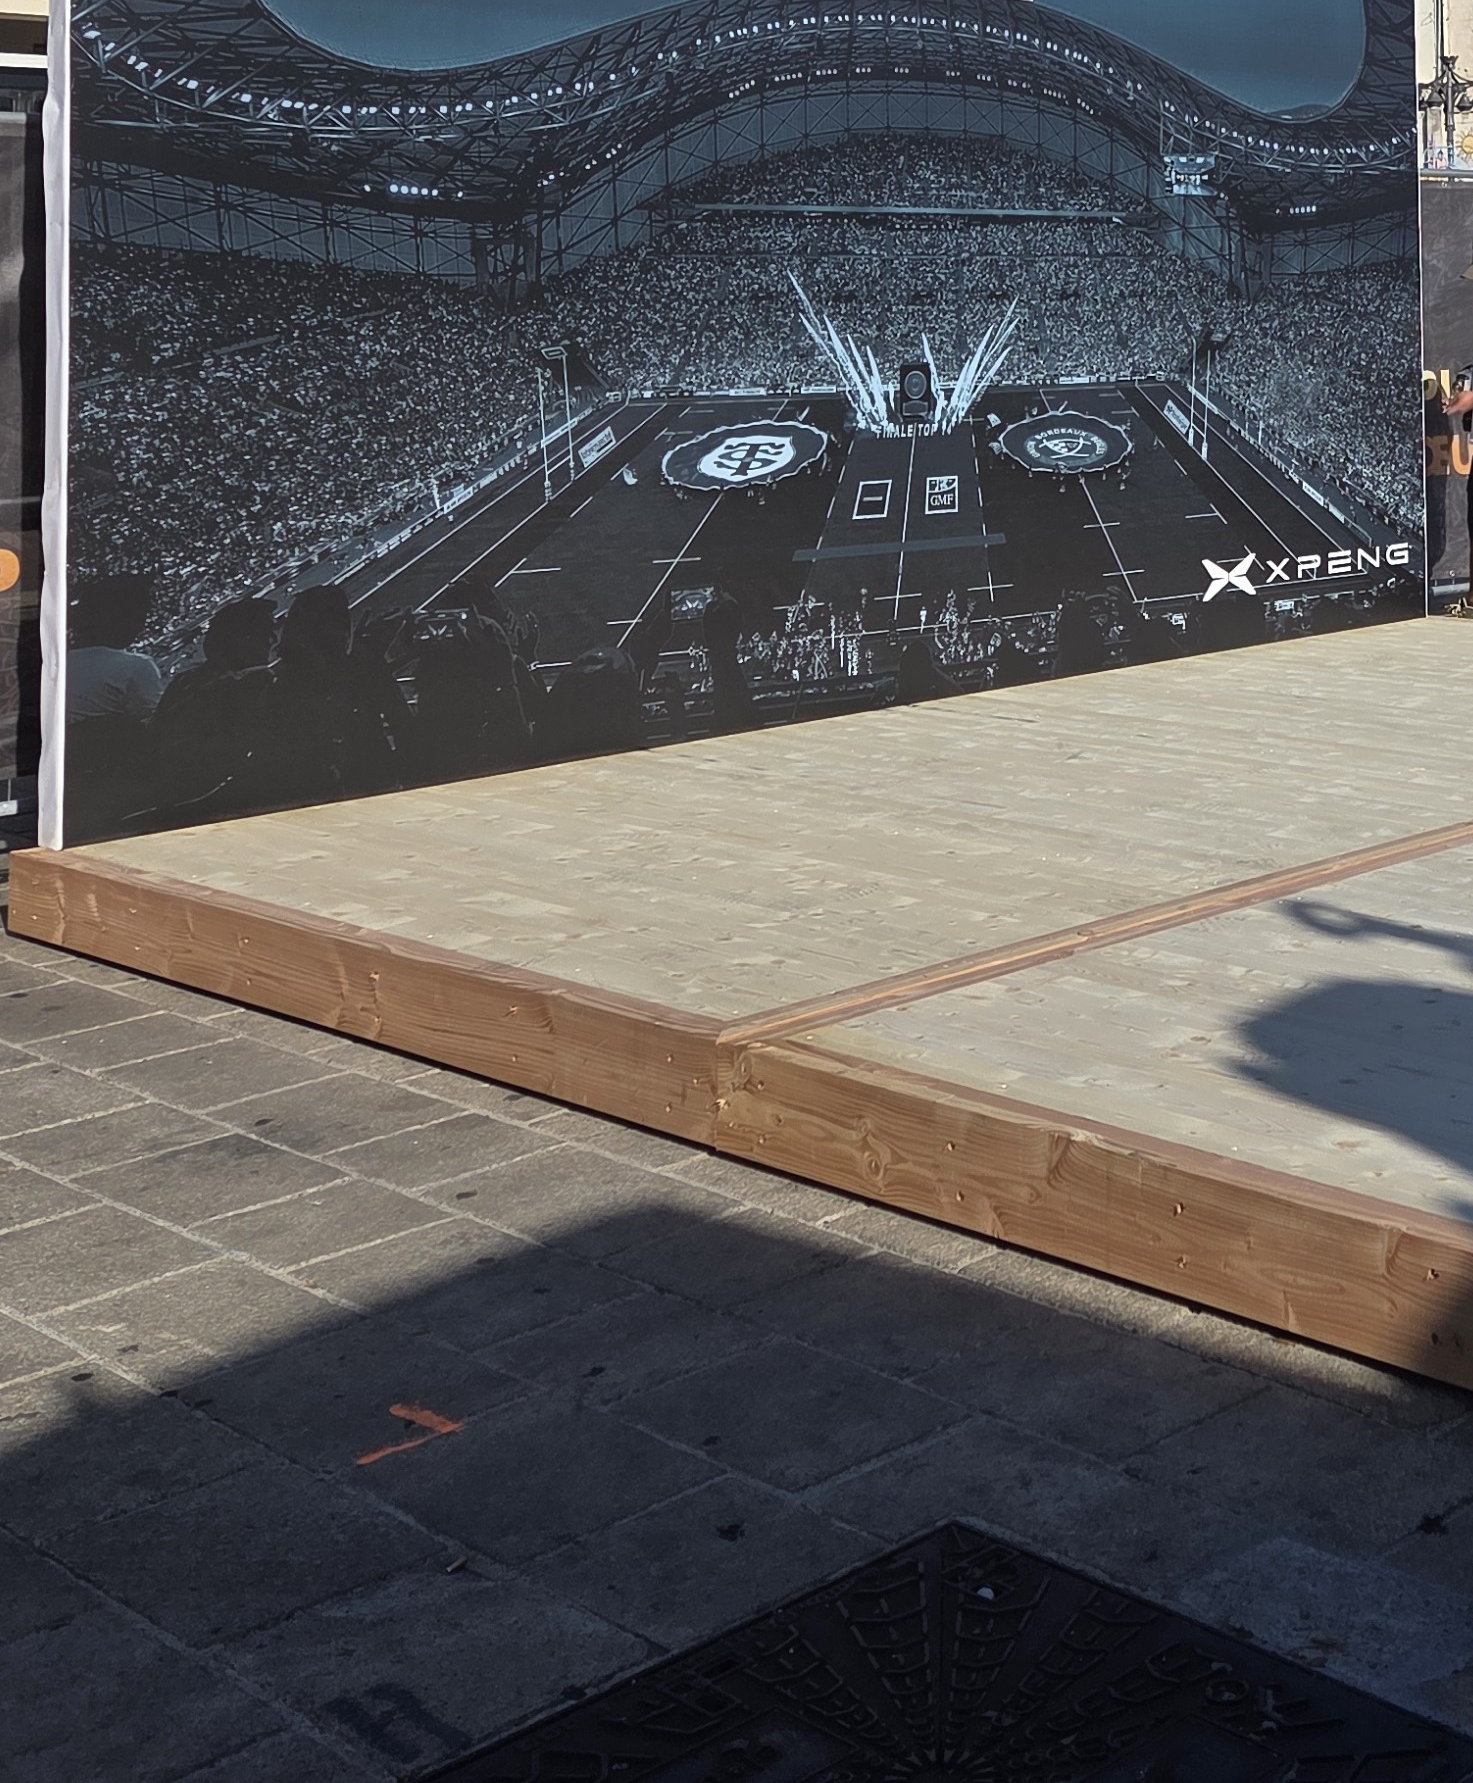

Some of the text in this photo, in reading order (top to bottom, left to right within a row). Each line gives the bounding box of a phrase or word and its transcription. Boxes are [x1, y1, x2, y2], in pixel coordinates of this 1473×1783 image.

[1034, 427, 1088, 440] BORDEAUX
[930, 493, 954, 506] GMF
[1266, 542, 1409, 583] XPENG
